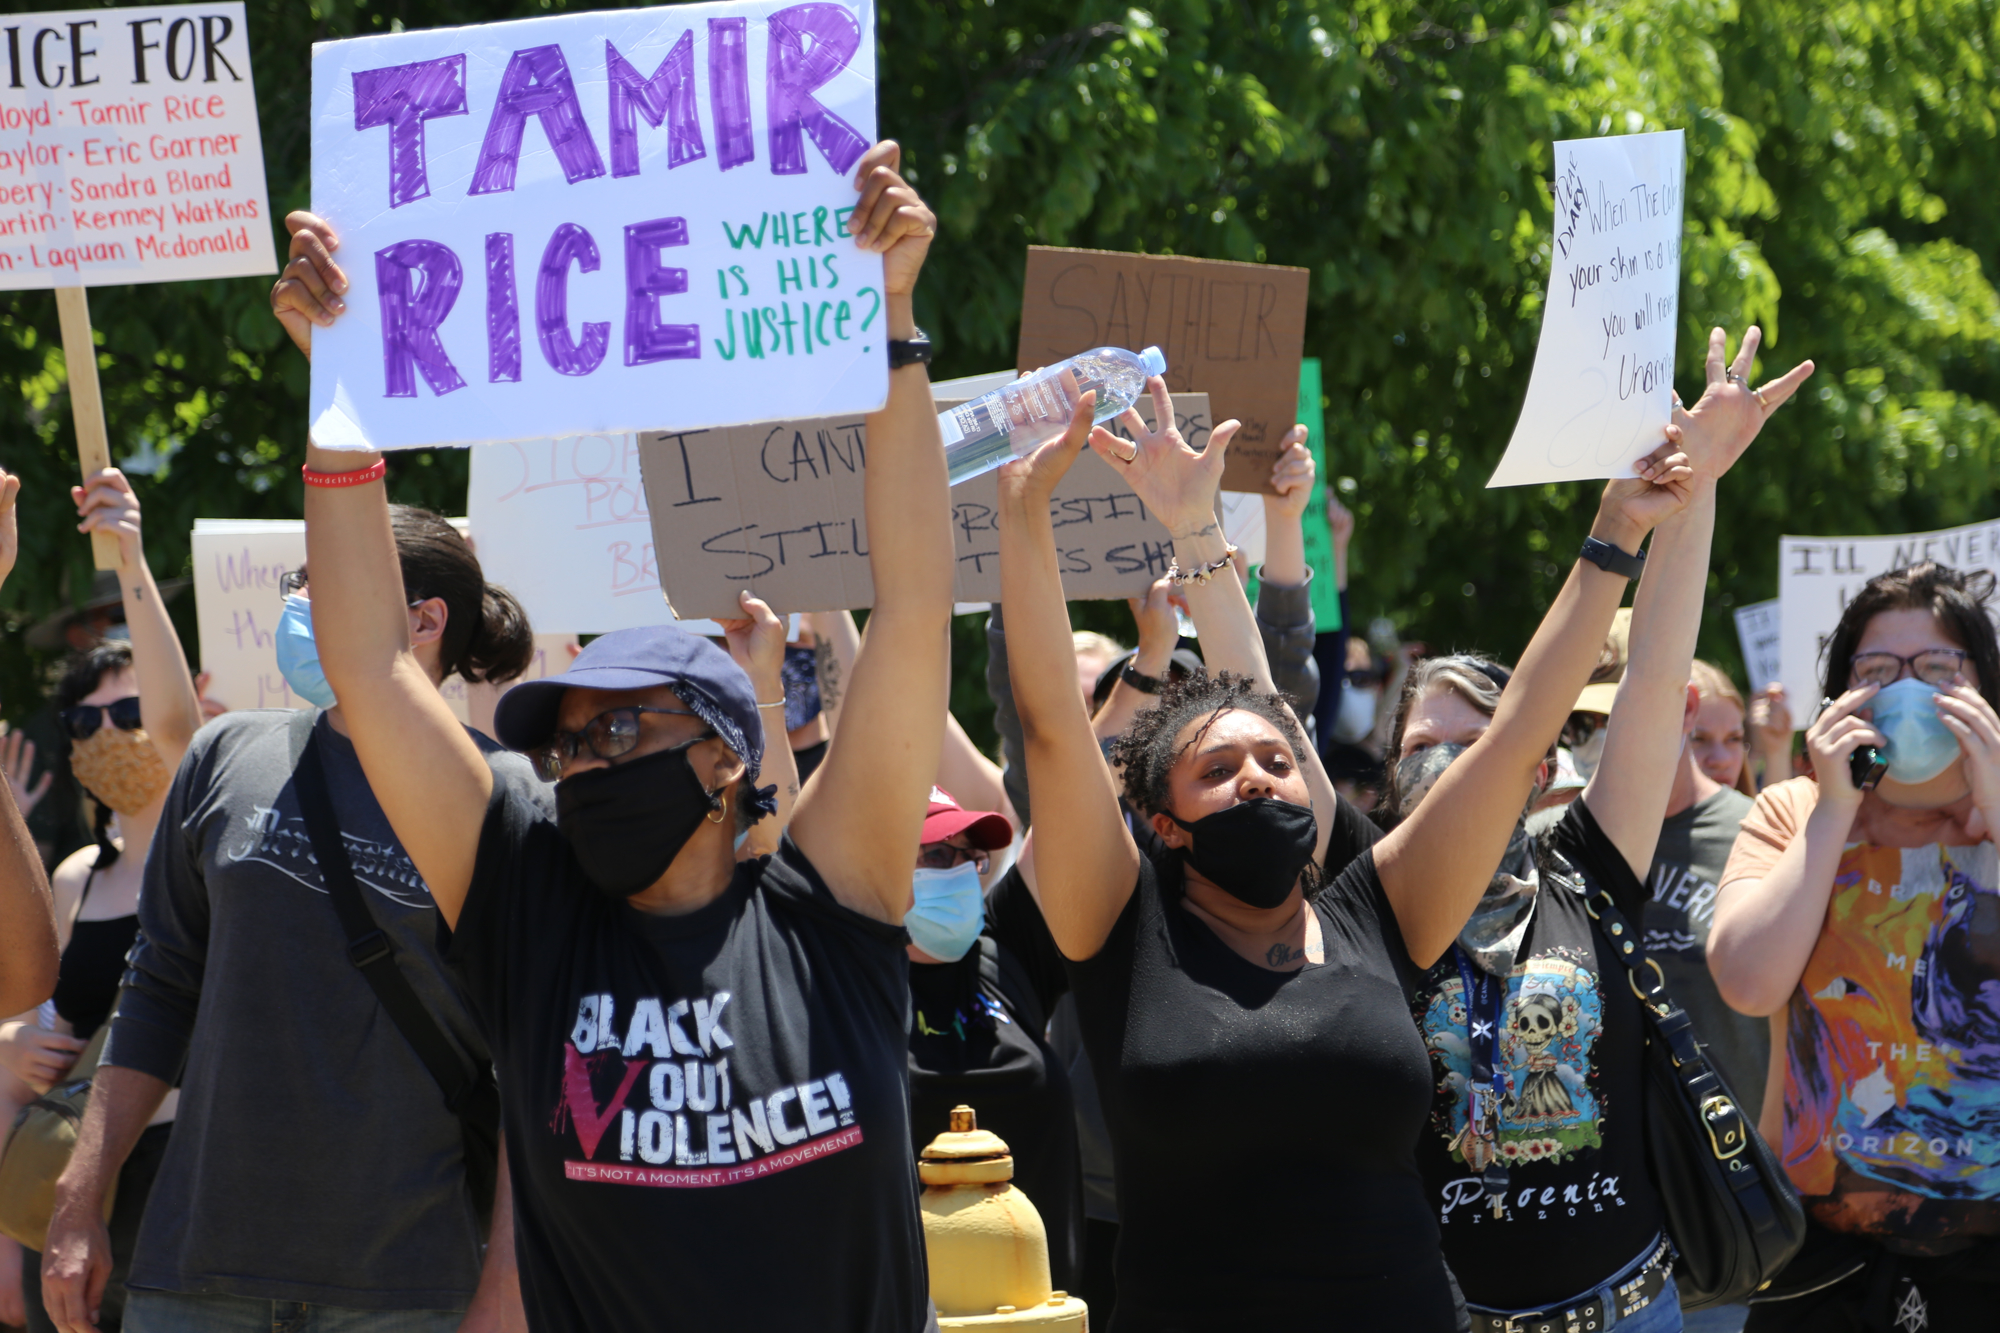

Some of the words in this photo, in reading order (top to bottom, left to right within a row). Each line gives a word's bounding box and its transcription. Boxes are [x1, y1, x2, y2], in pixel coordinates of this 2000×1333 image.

[127, 16, 243, 84] FOR
[71, 97, 150, 127] Tamir
[164, 94, 225, 124] Rice
[352, 2, 870, 208] TAMIR
[84, 134, 141, 167] Eric
[150, 133, 241, 162] Garner
[71, 172, 156, 203] Sandra
[167, 162, 232, 195] Bland
[72, 205, 165, 233] Kenney
[722, 206, 856, 250] WHERE
[1557, 175, 1587, 261] DIARY
[30, 240, 125, 272] Laquan
[717, 265, 749, 299] IS
[777, 253, 839, 294] HIS
[375, 216, 701, 398] RICE
[1048, 263, 1155, 358] SAY
[1160, 272, 1278, 363] THEIR
[1603, 311, 1625, 361] you
[659, 430, 722, 507] I
[583, 477, 650, 522] POL
[701, 517, 869, 581] STIL
[1886, 952, 1928, 978] ME
[571, 991, 734, 1059] BLACK
[1866, 1040, 1933, 1062] THE
[650, 1057, 733, 1113] OUT
[1821, 1132, 1974, 1157] HORIZON
[600, 1168, 634, 1181] NOT
[636, 1172, 647, 1183] A
[728, 1166, 755, 1182] IT'S
[757, 1163, 768, 1175] A
